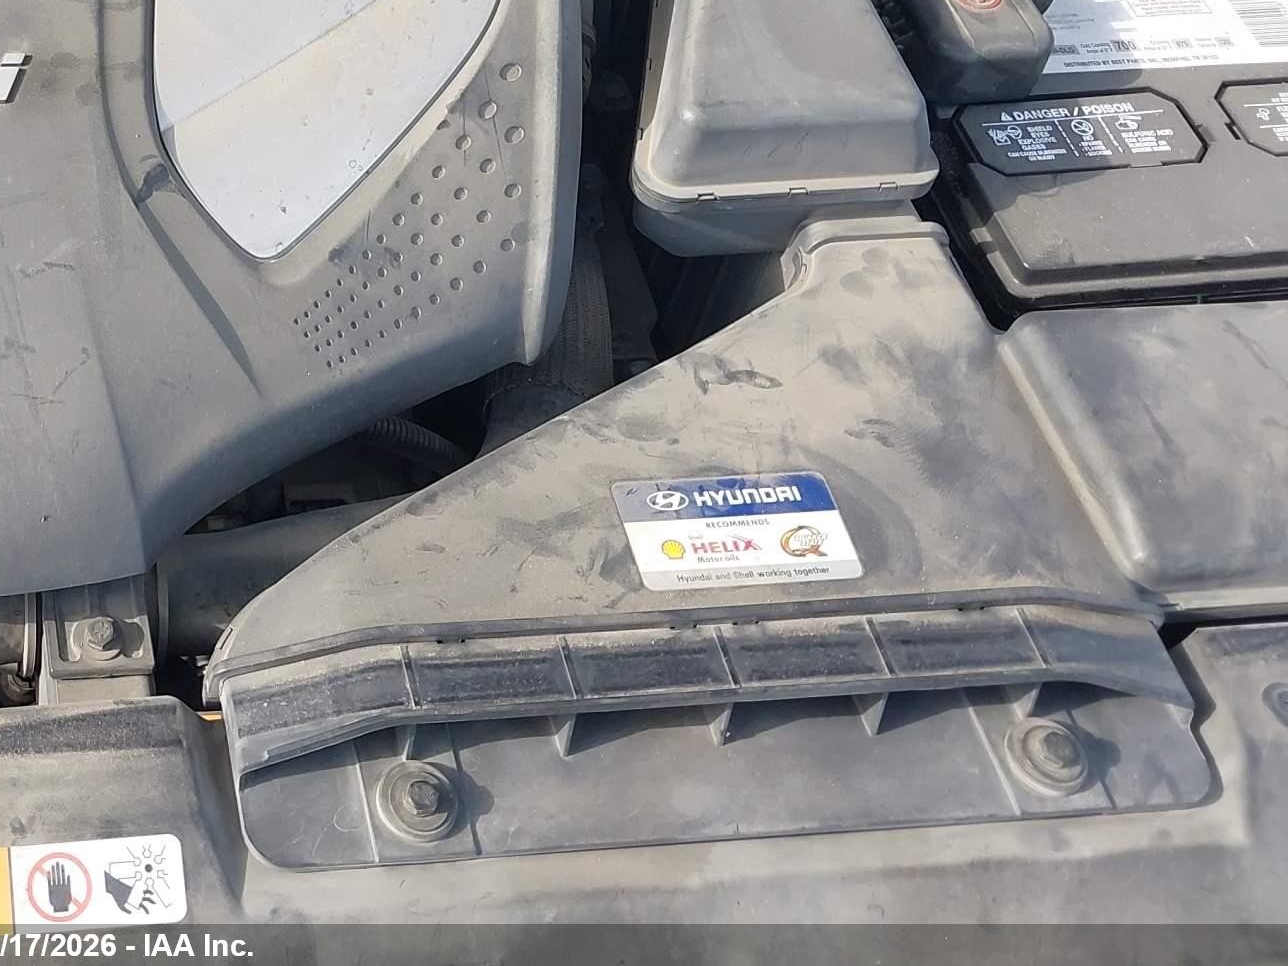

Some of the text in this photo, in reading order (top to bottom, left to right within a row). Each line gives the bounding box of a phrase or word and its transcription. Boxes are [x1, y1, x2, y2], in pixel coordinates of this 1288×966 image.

[1113, 40, 1136, 51] 700
[1012, 107, 1070, 121] DANGER
[1081, 102, 1135, 115] POISON
[694, 485, 802, 507] HYUNDAI
[705, 518, 770, 529] RECOMMENDS
[691, 538, 756, 555] HELIX
[677, 565, 830, 584] Hyundai and Shell working together
